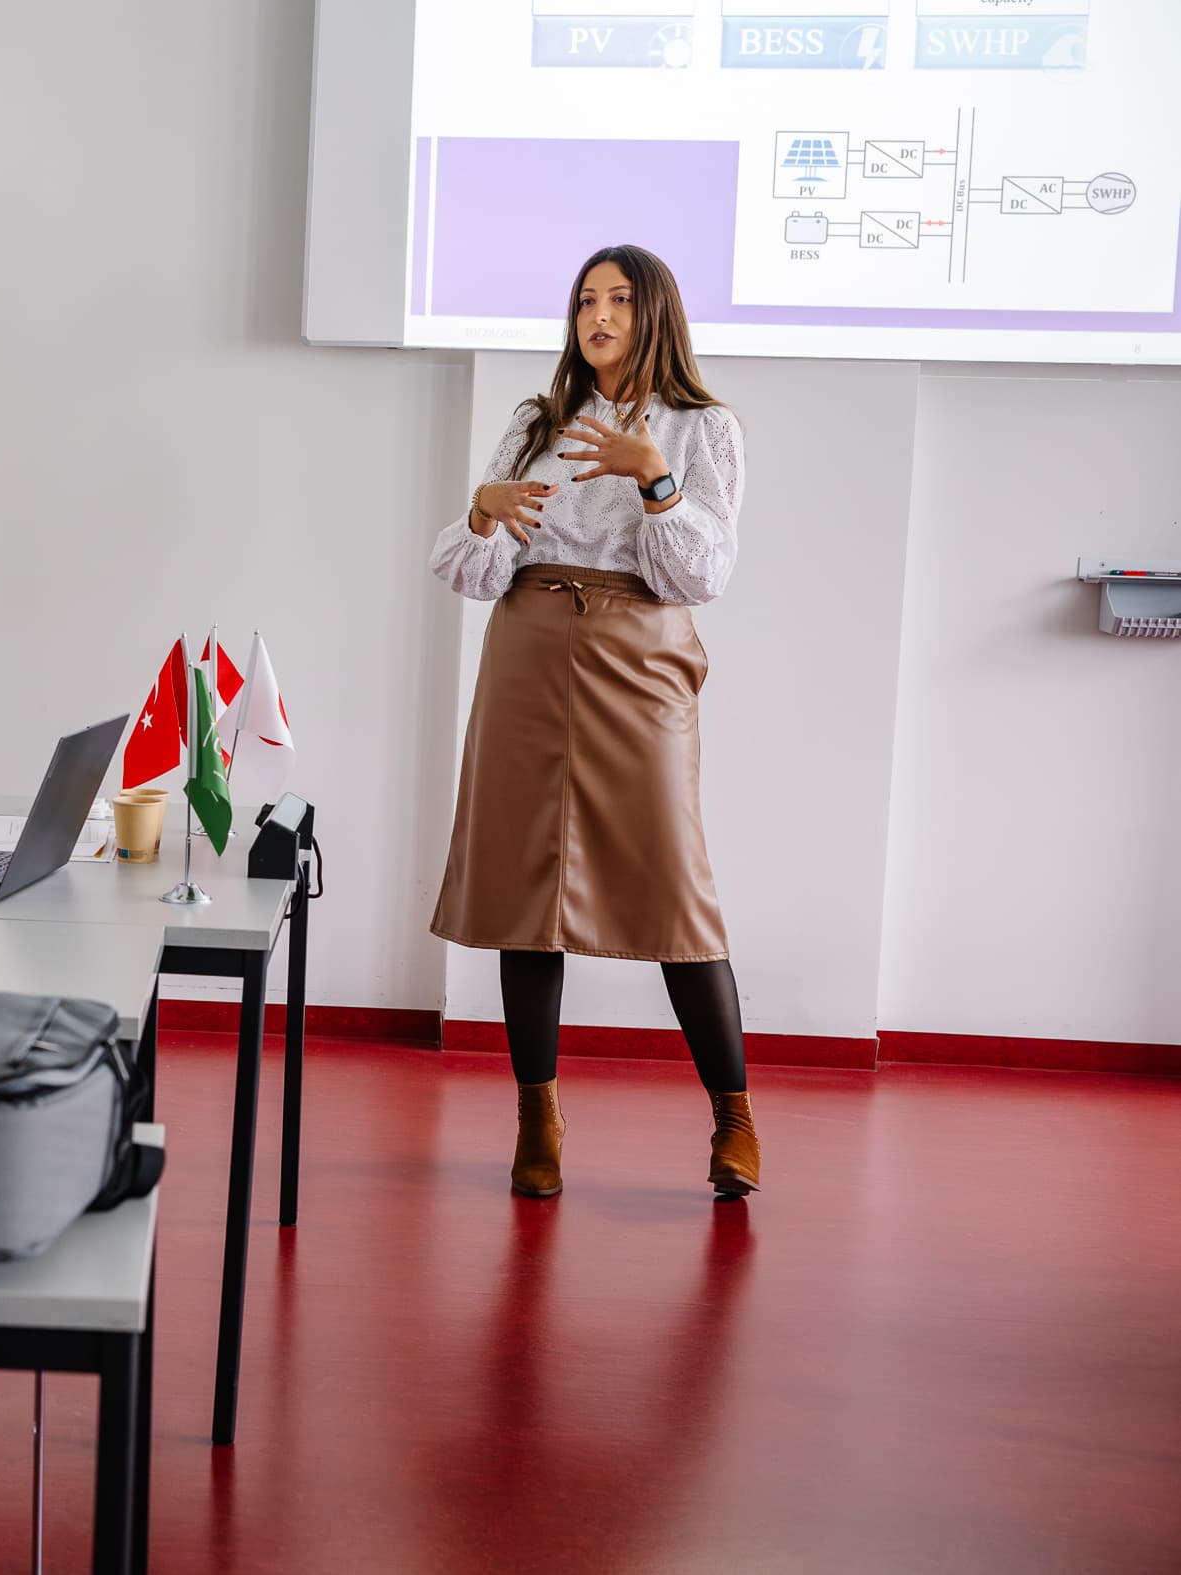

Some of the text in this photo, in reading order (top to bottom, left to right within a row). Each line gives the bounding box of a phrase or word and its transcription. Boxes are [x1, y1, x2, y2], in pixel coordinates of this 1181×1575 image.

[569, 27, 615, 54] PV
[738, 28, 824, 55] BESS
[927, 28, 1031, 55] SWHP
[900, 149, 918, 159] DC
[871, 163, 888, 173] DC
[799, 186, 816, 196] PV
[1039, 184, 1057, 193] AC
[1092, 188, 1131, 199] SWHP
[1010, 199, 1028, 210] DC
[896, 219, 913, 229] DC
[867, 234, 884, 244] DC
[790, 250, 820, 260] BESS
